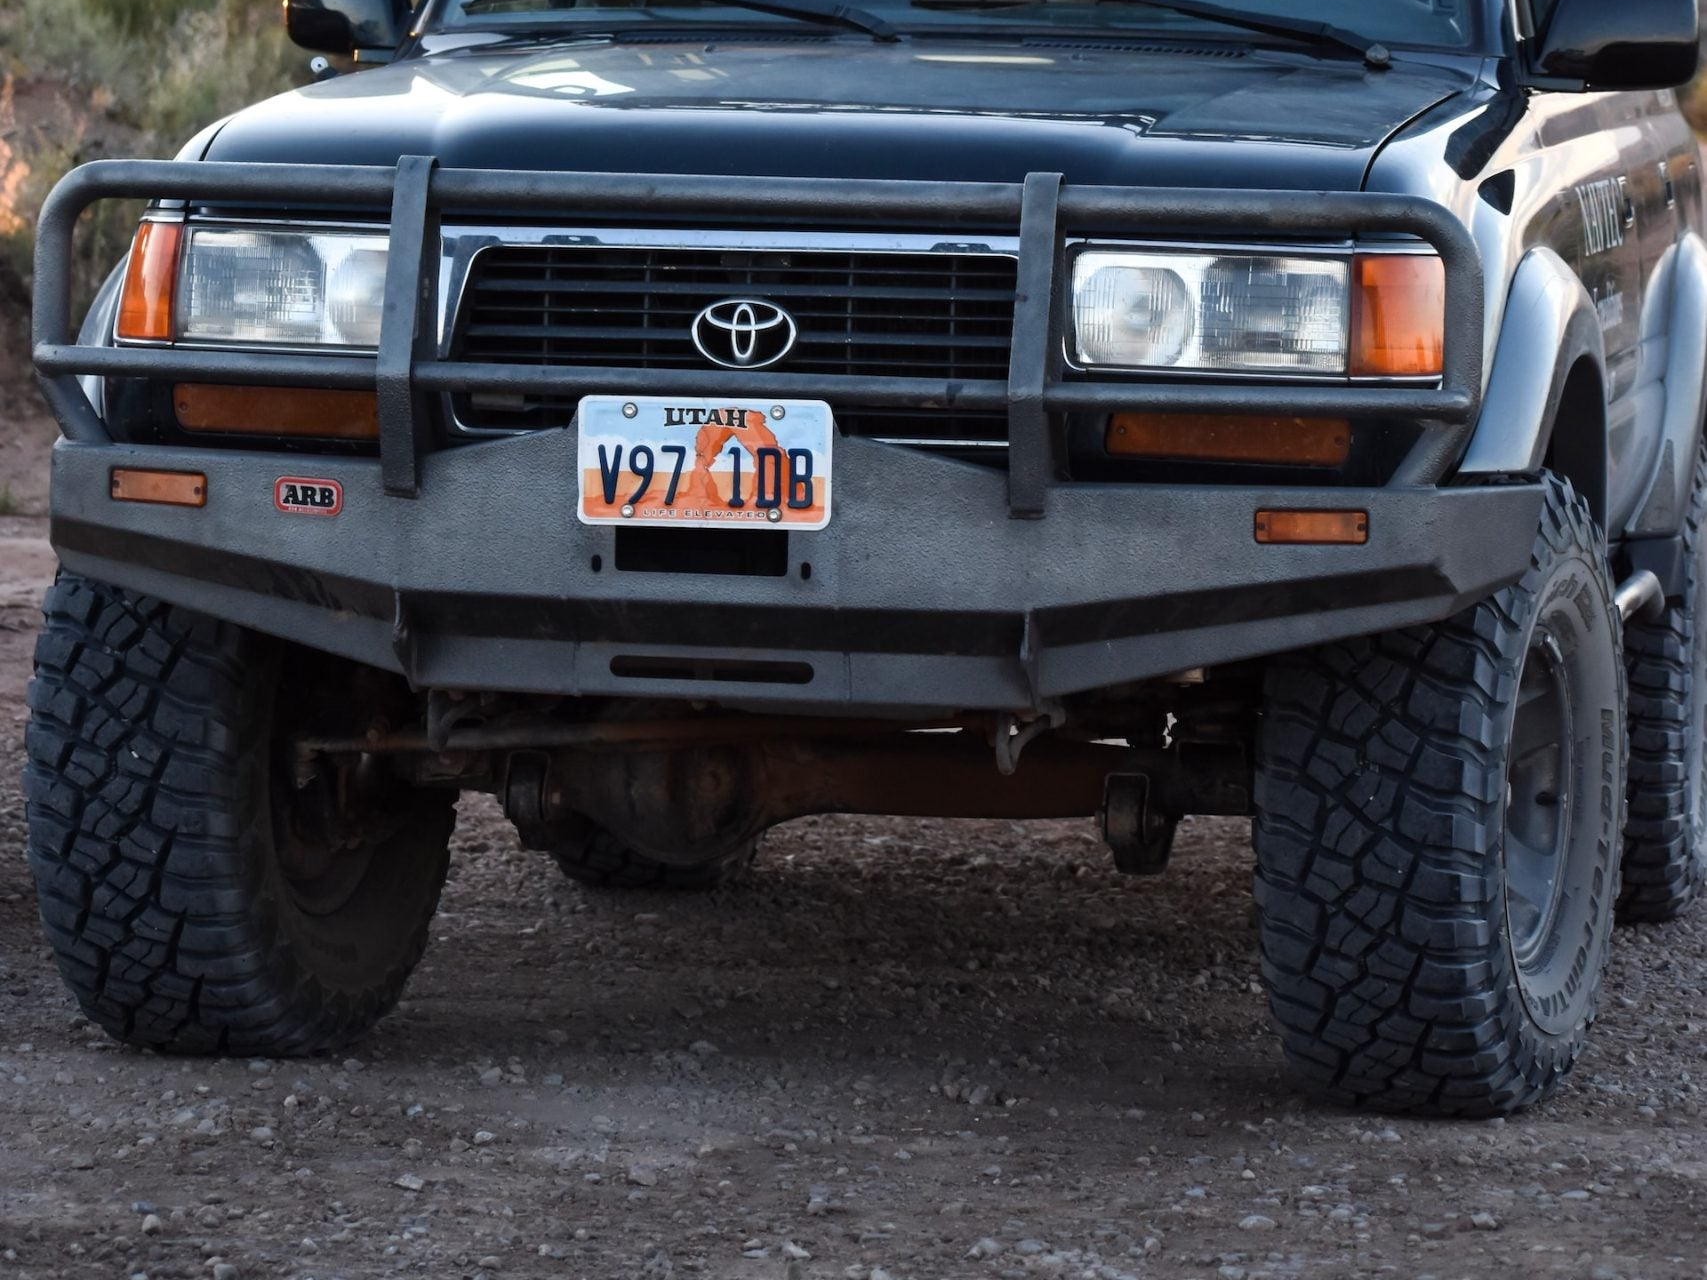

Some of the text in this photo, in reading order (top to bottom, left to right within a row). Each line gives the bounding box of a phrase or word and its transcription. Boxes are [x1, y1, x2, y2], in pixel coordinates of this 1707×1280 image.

[664, 407, 747, 429] UTAH
[598, 444, 813, 509] V97 1DB
[282, 484, 334, 508] ARB
[643, 509, 767, 519] LIFE ELEVATED
